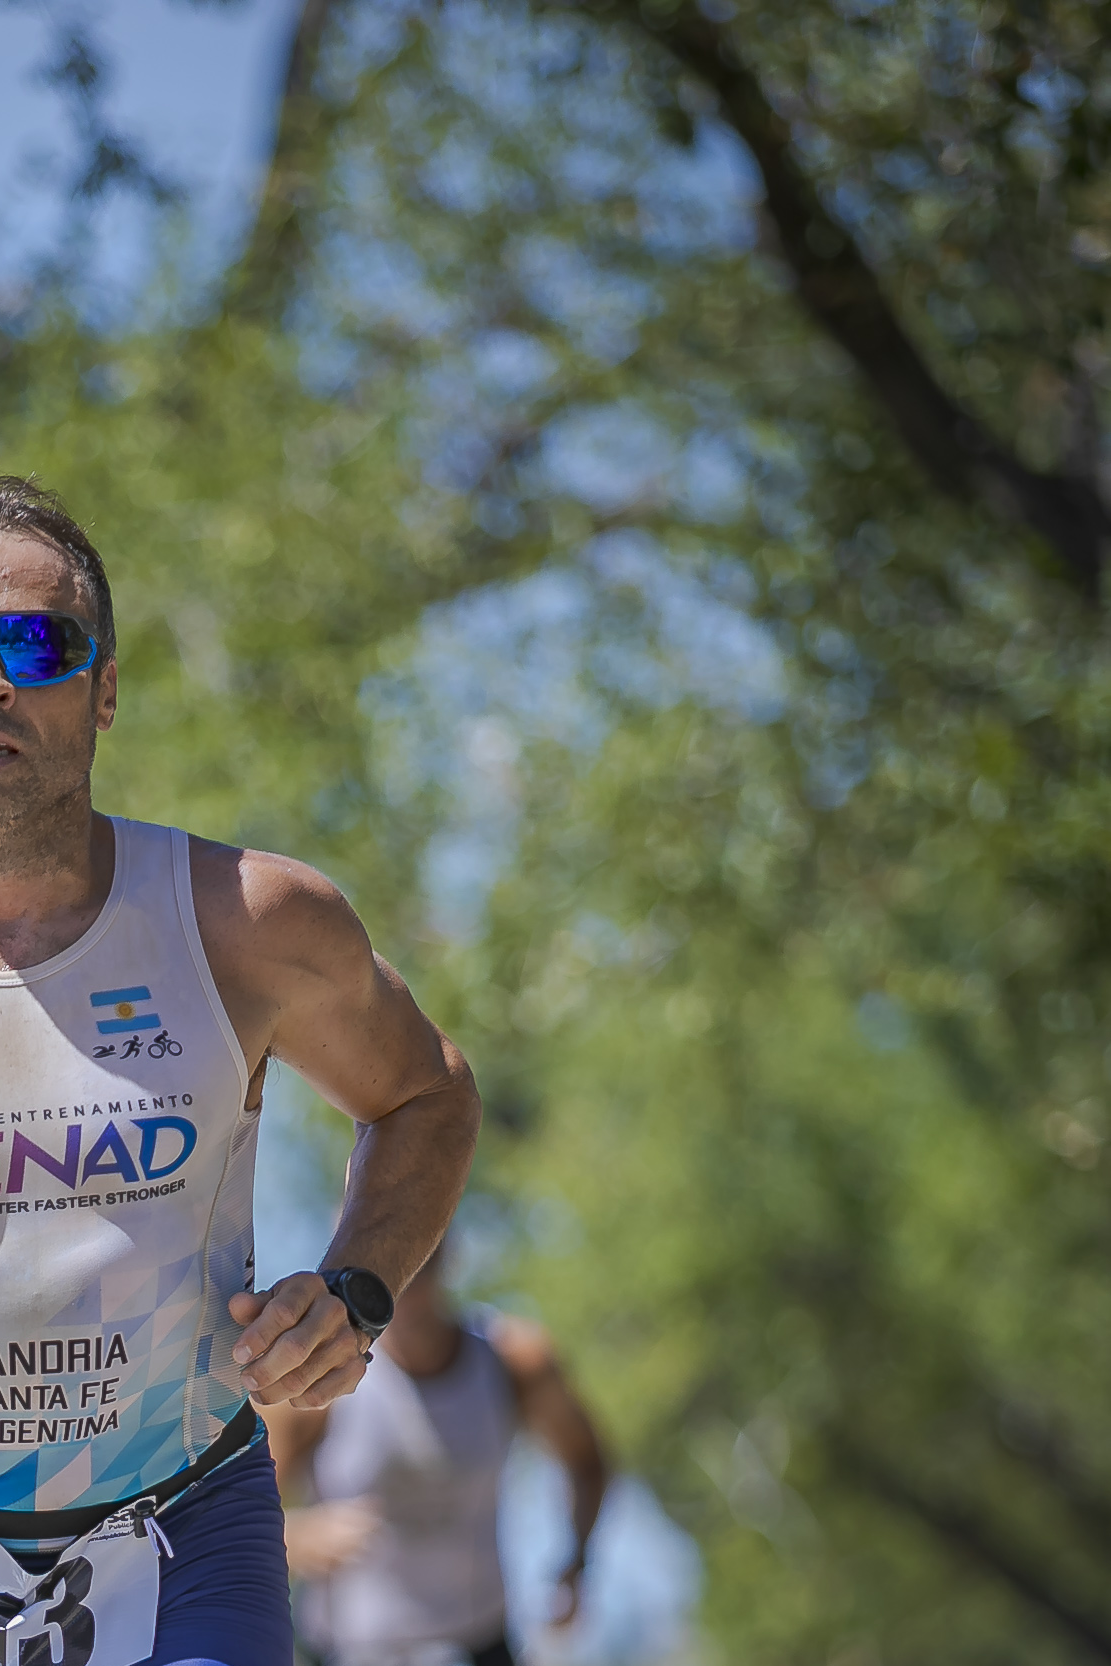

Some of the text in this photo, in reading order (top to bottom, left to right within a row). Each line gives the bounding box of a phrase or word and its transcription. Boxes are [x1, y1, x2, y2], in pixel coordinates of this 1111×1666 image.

[34, 1193, 101, 1213] FASTER
[105, 1178, 186, 1206] STRONGER
[81, 1377, 120, 1409] FE
